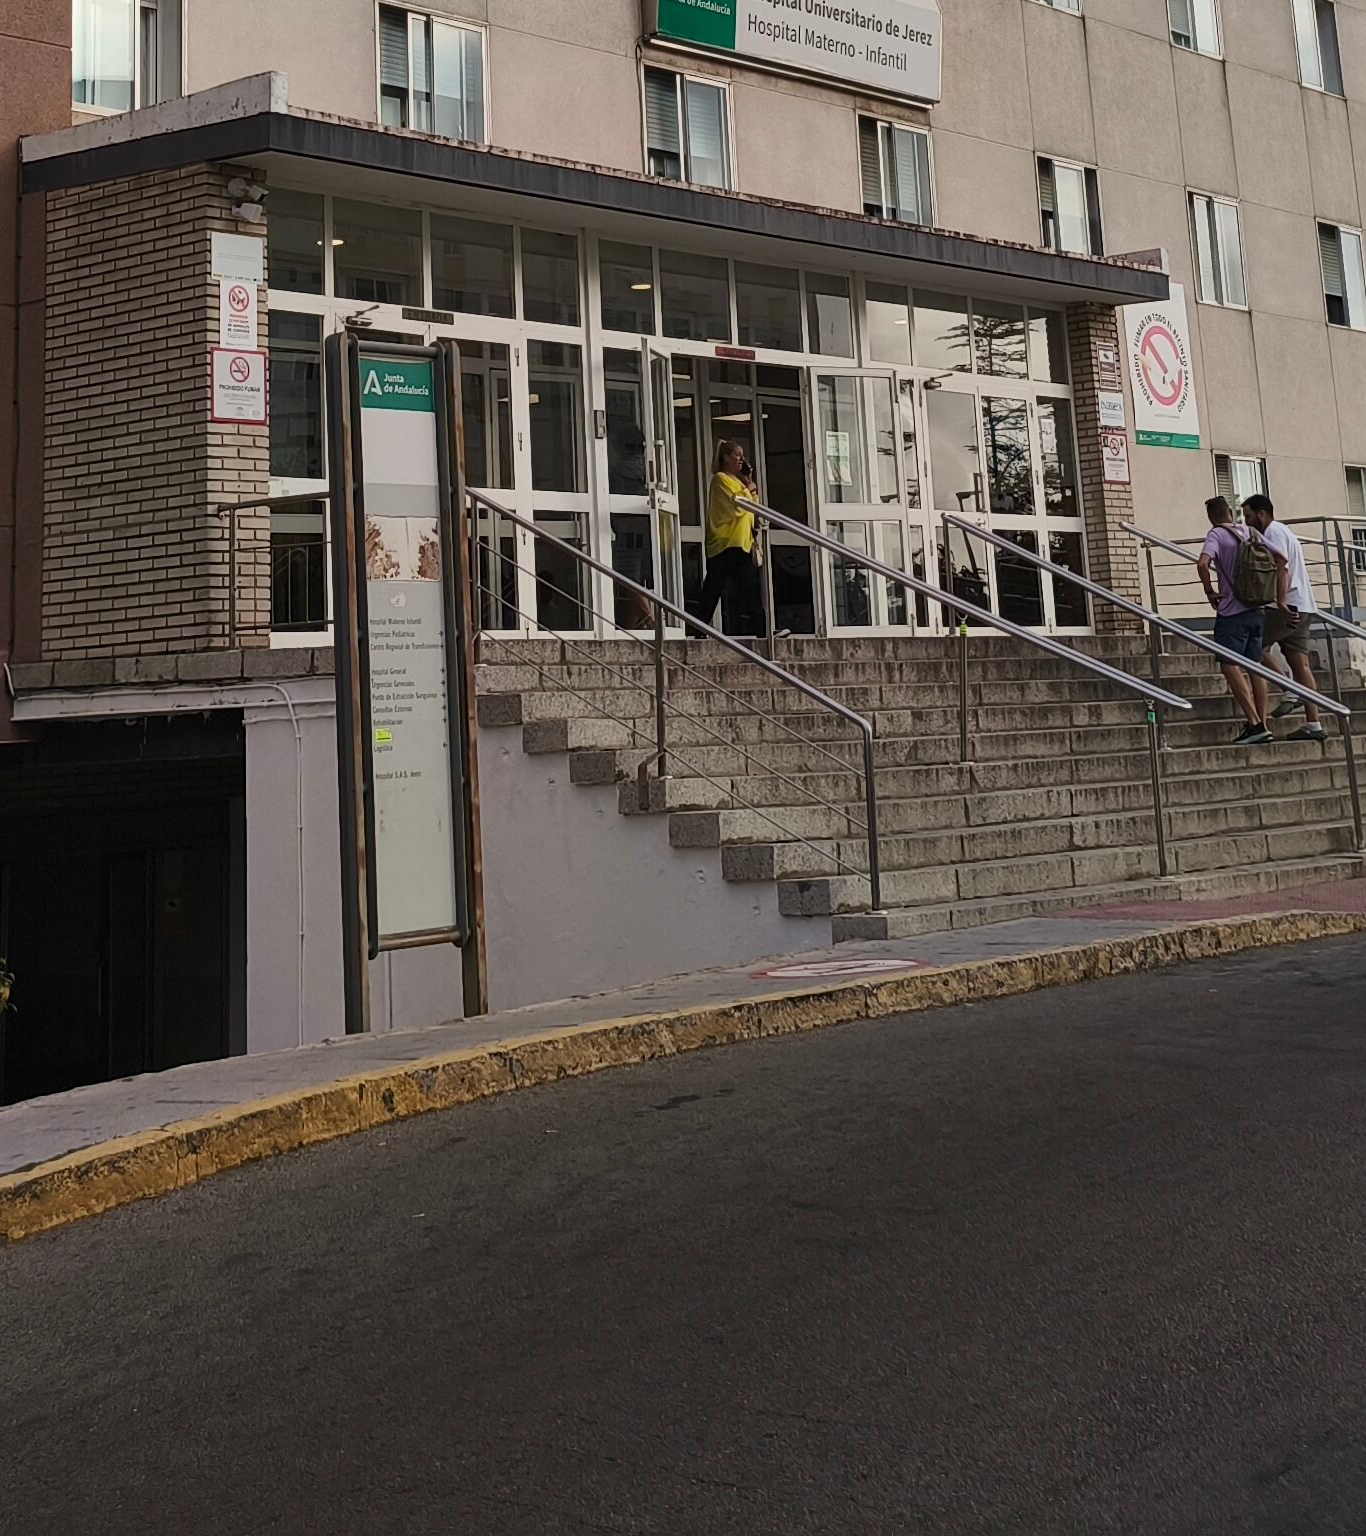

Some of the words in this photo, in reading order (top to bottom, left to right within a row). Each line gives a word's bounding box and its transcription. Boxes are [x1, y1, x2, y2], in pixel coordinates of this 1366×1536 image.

[748, 13, 801, 44] Hospital
[804, 28, 856, 58] Materno
[866, 44, 907, 72] Infantil
[885, 19, 900, 38] de
[902, 24, 933, 46] Jerez
[1134, 319, 1146, 348] FUMAR
[383, 373, 405, 383] Junta
[383, 384, 394, 393] de
[394, 384, 429, 396] Andalucía
[1133, 354, 1154, 407] PROHIBIDO
